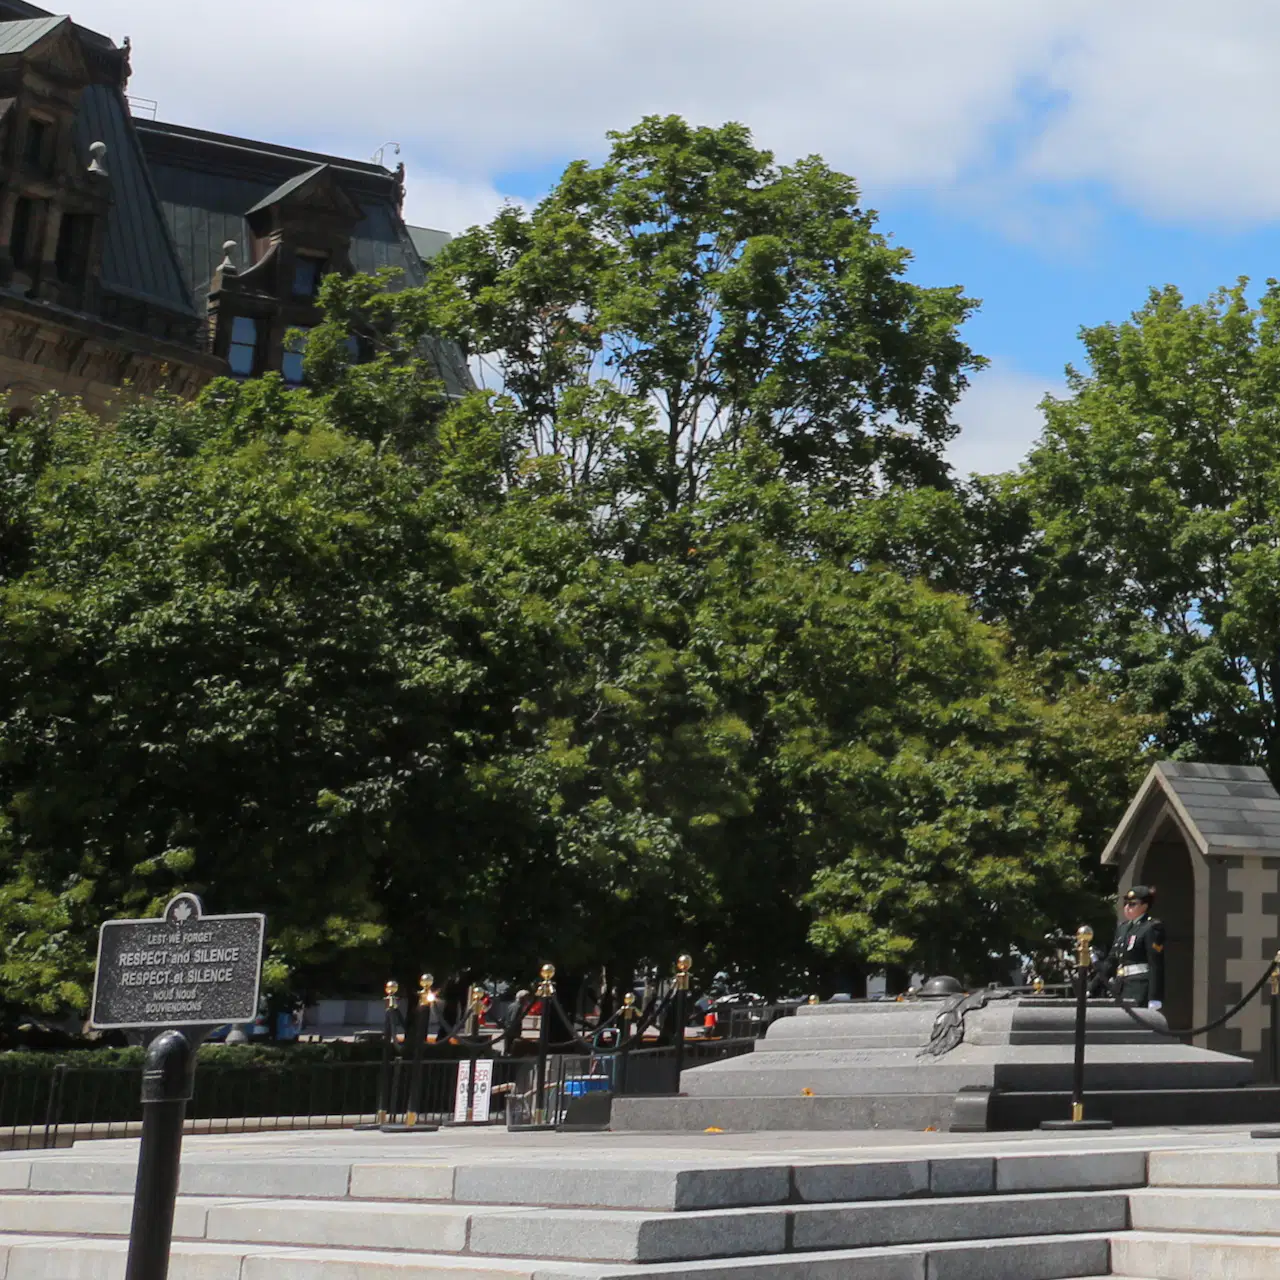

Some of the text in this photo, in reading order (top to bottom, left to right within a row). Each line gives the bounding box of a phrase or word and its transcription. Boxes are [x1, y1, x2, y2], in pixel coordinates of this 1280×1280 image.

[147, 931, 213, 945] LEST WE FORGET
[119, 947, 240, 967] RESPECT and SILENCE
[121, 967, 234, 986] RESPECT et SILENCE
[153, 988, 197, 1001] NOUS NOUS
[145, 1001, 202, 1014] SOUVIENDRONS
[460, 1069, 489, 1081] DAGER
